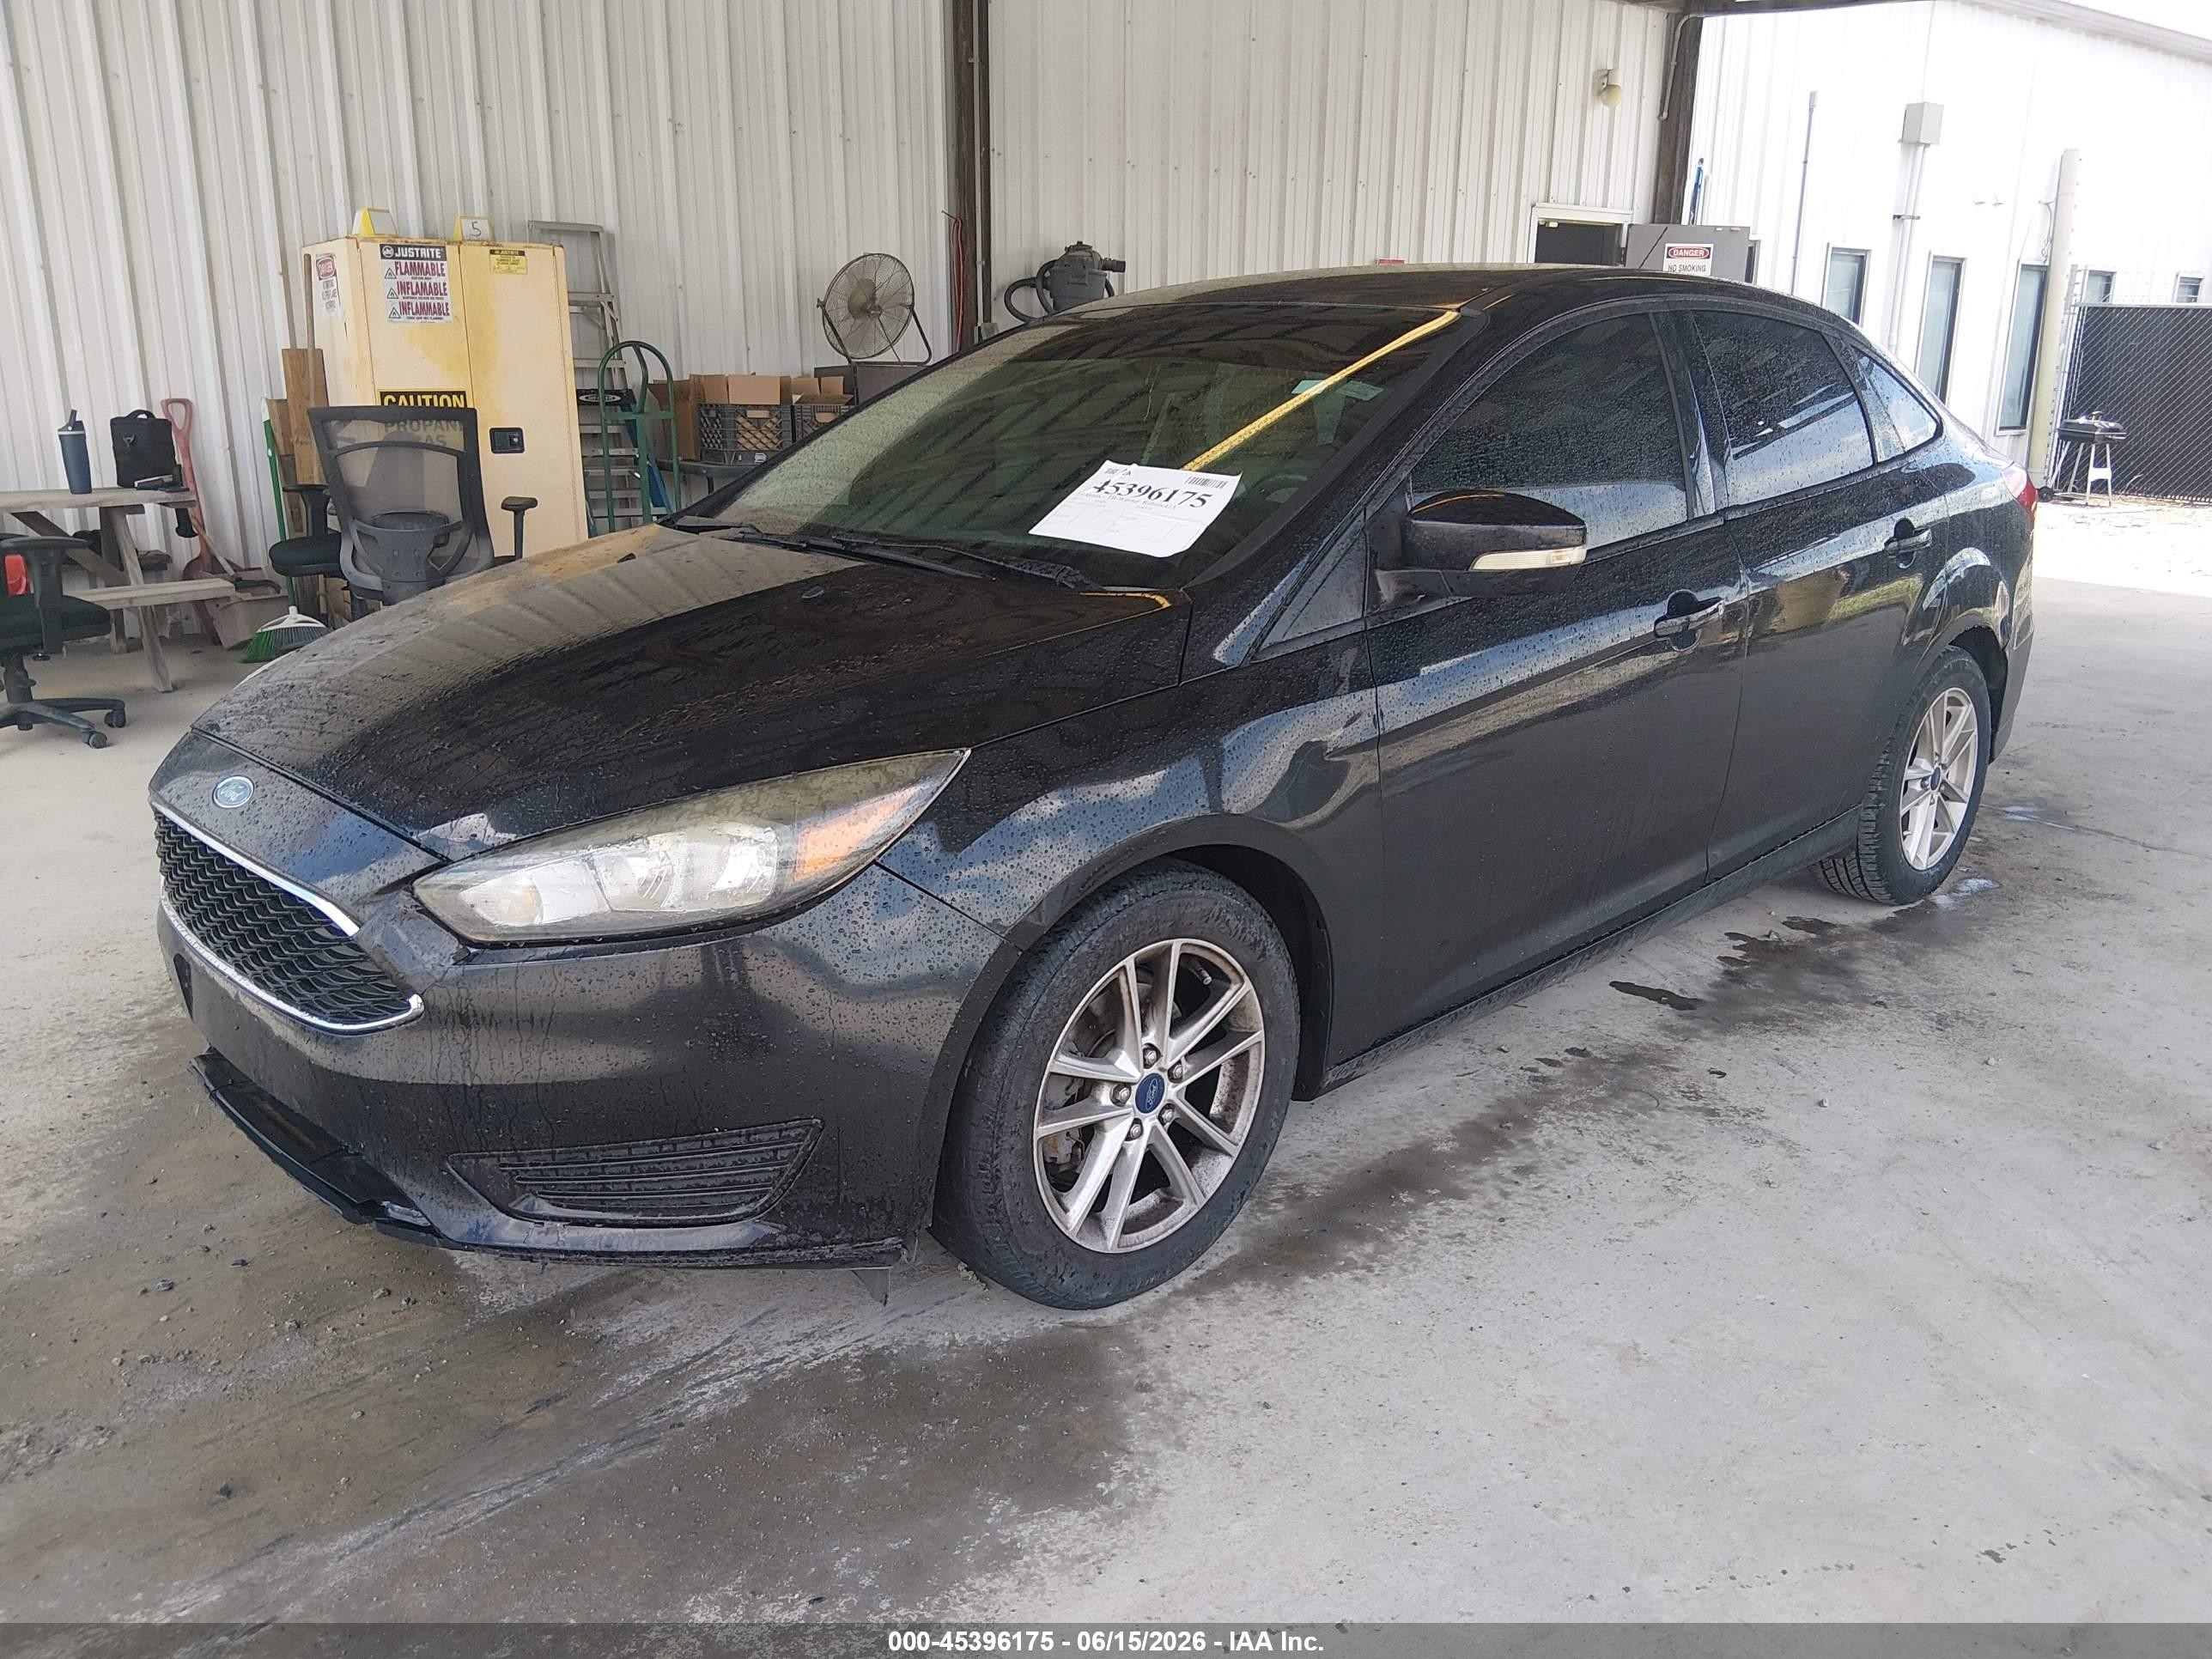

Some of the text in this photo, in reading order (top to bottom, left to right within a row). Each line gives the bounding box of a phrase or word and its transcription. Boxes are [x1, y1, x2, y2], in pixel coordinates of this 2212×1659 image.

[471, 221, 483, 237] 5
[394, 246, 441, 258] JUSTRITE
[394, 261, 446, 276] FLAMMABLE
[397, 281, 448, 296] INFLAMABLE
[398, 301, 450, 316] INFLAMMABLE
[1093, 478, 1214, 508] 45396175
